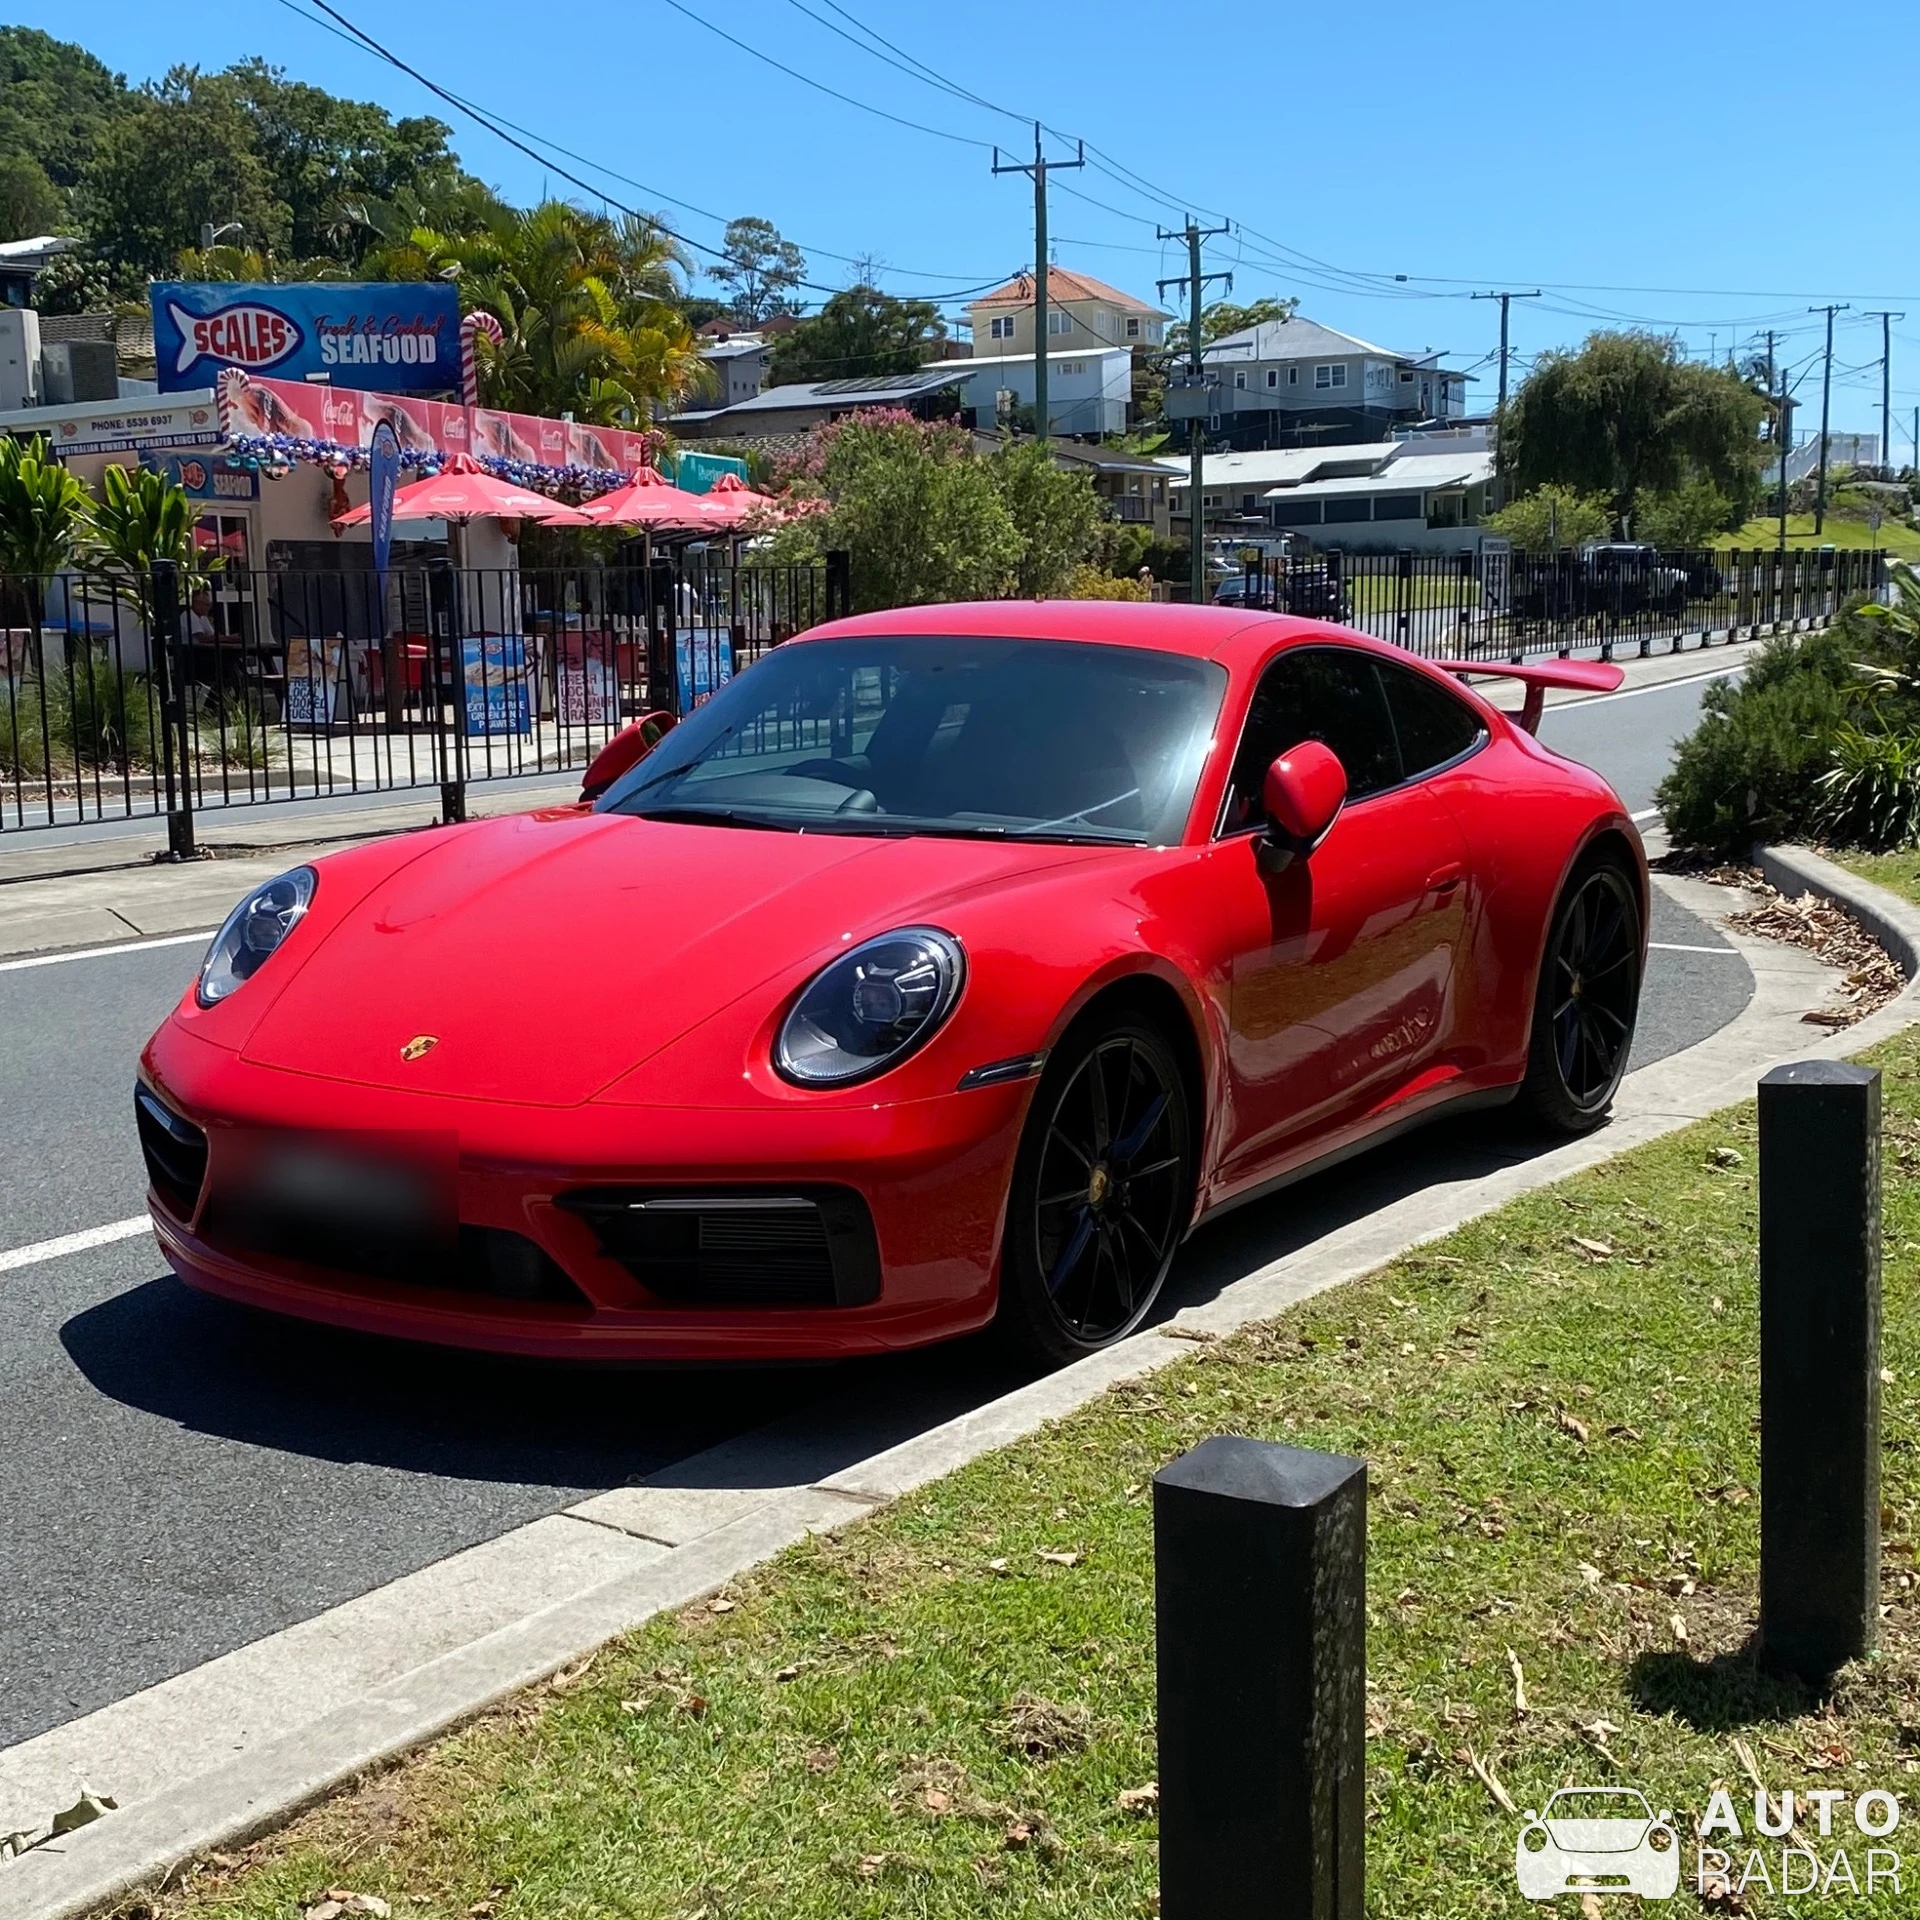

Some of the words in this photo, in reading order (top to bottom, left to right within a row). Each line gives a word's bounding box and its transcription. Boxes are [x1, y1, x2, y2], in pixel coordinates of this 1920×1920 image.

[193, 312, 287, 363] SCALES
[314, 314, 357, 338] Fresh
[362, 315, 377, 335] &
[382, 314, 446, 338] Cooked
[320, 334, 437, 365] SEAFOOD
[91, 418, 125, 431] PHONE:
[151, 414, 172, 426] 6937
[55, 442, 100, 456] AUSTRALIAN
[100, 440, 127, 452] OWNED
[128, 441, 135, 449] &
[135, 436, 172, 450] OPERATED
[174, 433, 196, 446] SINCE
[560, 673, 598, 685] FREH
[466, 702, 496, 712] EXTA
